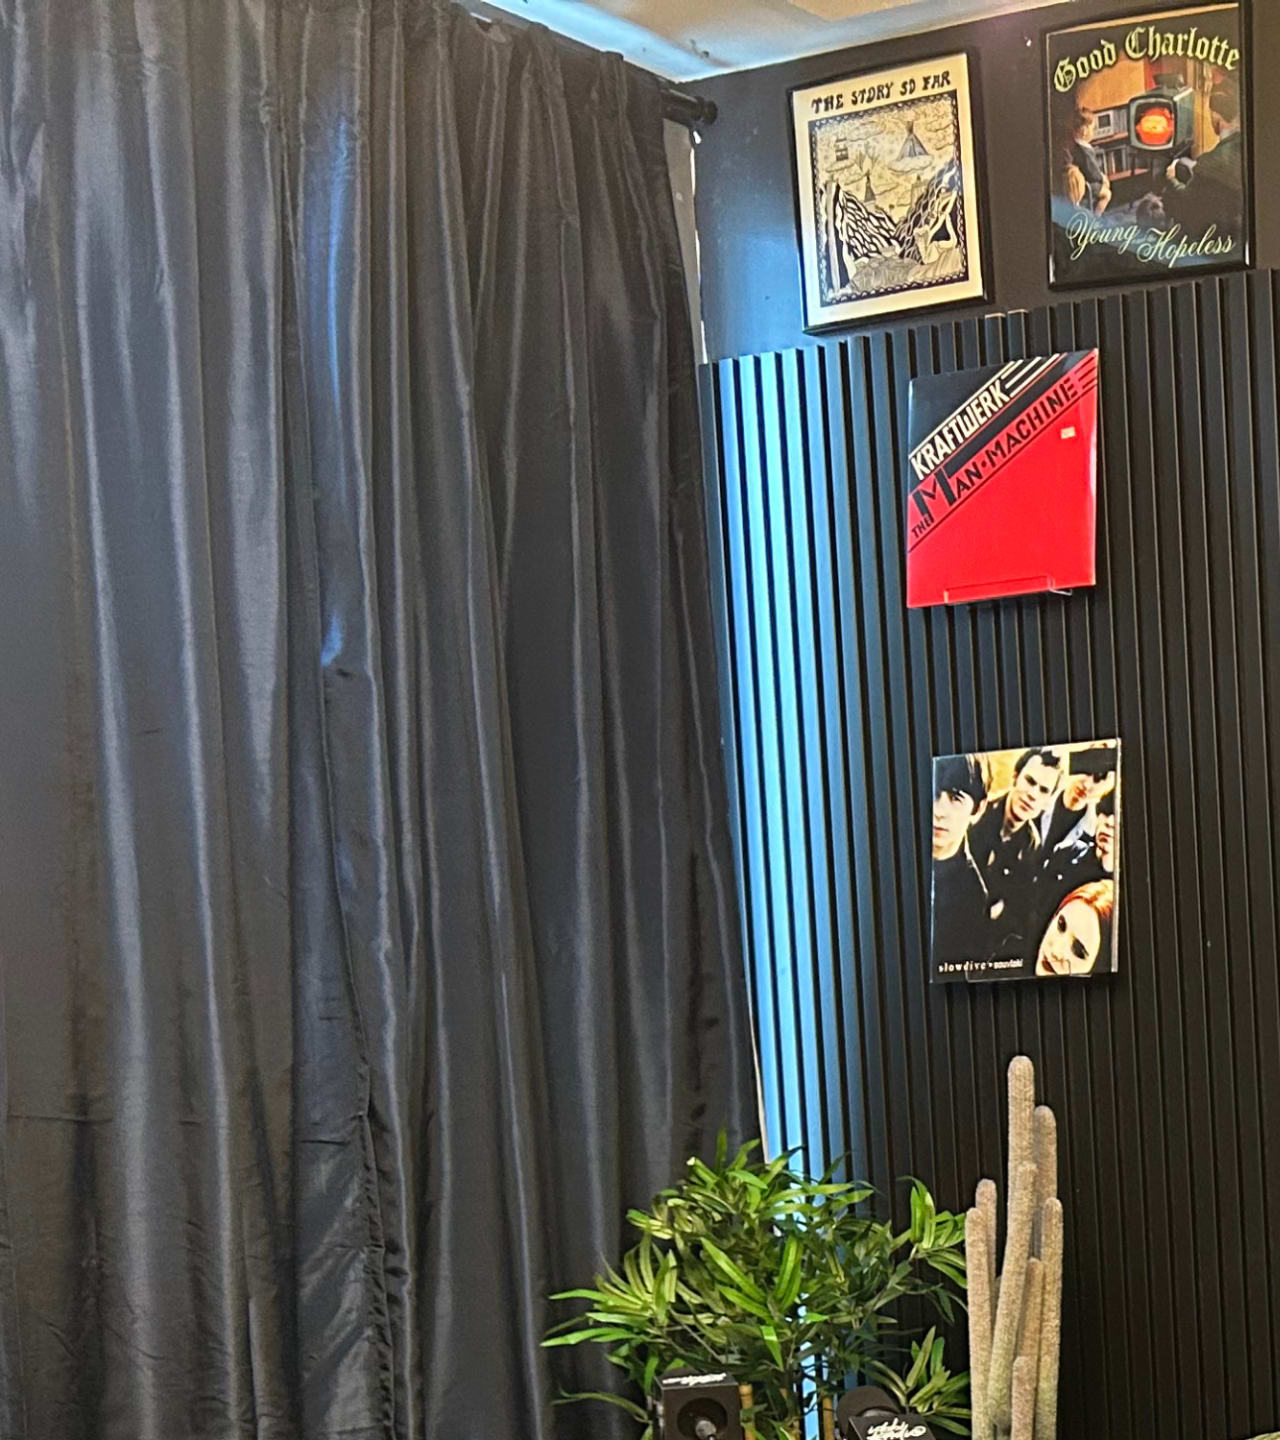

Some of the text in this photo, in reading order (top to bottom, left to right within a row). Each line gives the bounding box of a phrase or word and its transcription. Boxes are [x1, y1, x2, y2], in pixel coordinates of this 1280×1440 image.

[1054, 26, 1240, 92] Good Charlotte
[811, 71, 951, 114] THE STORY SO FAR
[1066, 212, 1138, 261] Young
[1137, 223, 1236, 268] Hopeless
[911, 379, 1011, 481] KRAFTWERK
[912, 514, 935, 539] THE
